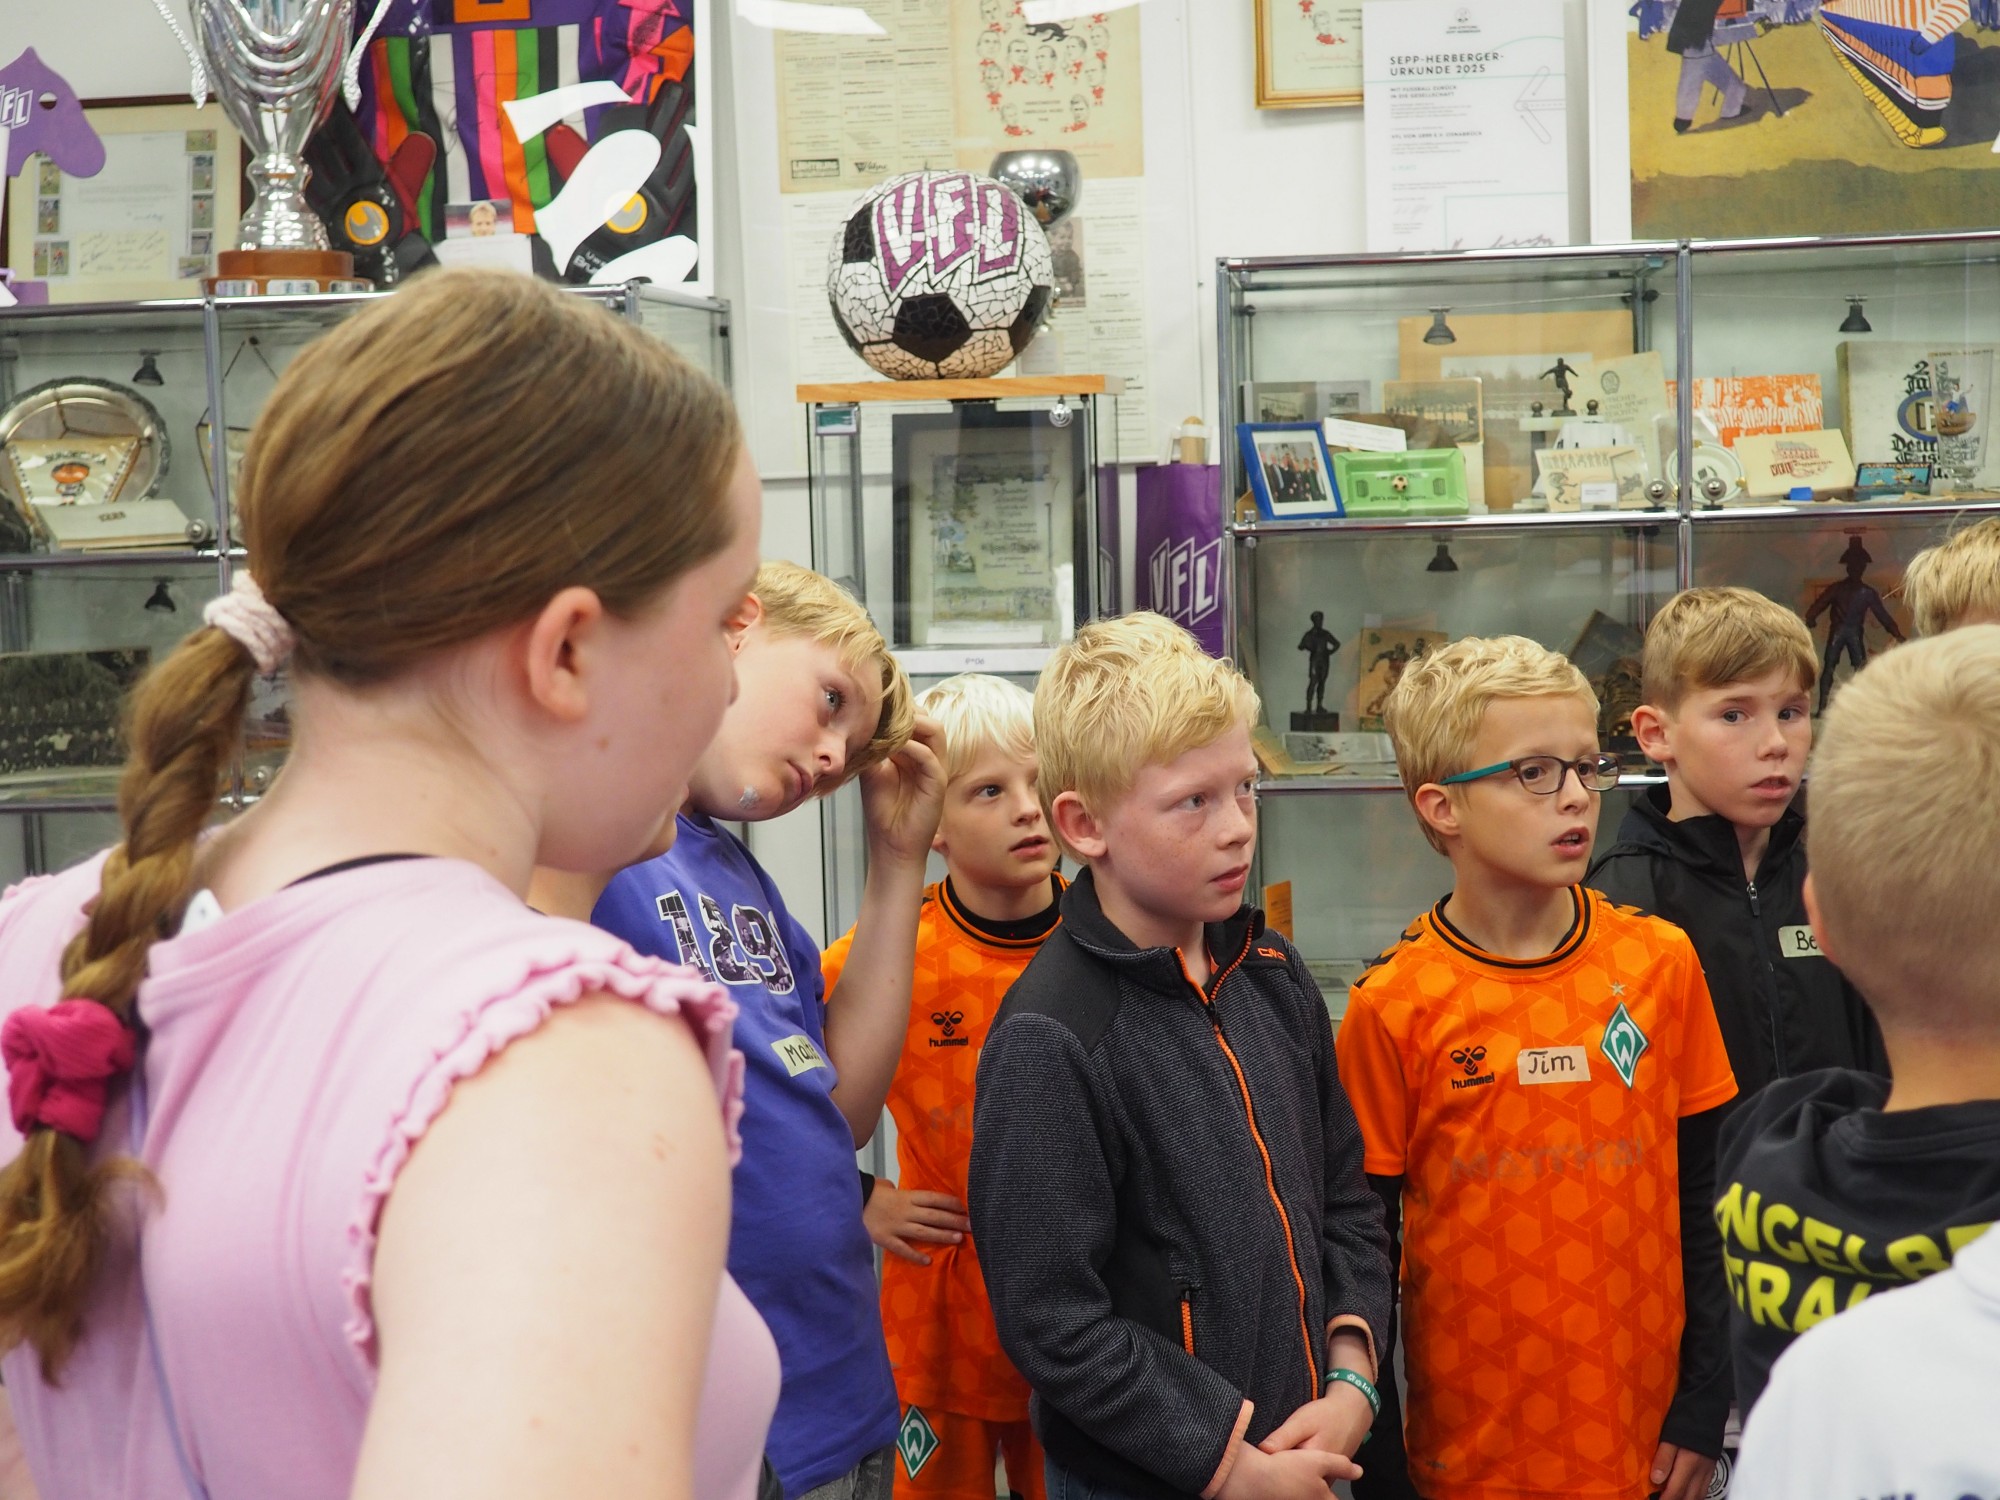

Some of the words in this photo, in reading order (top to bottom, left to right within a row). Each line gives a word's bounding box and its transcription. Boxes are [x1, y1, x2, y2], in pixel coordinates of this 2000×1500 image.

[1390, 52, 1504, 65] SEPP-HERBERGER-
[1390, 65, 1451, 76] URKUNDE
[1456, 63, 1486, 74] 2025
[656, 890, 795, 995] 189
[929, 1036, 968, 1047] hummel
[1527, 1051, 1576, 1074] Tim
[1451, 1072, 1495, 1089] hummel
